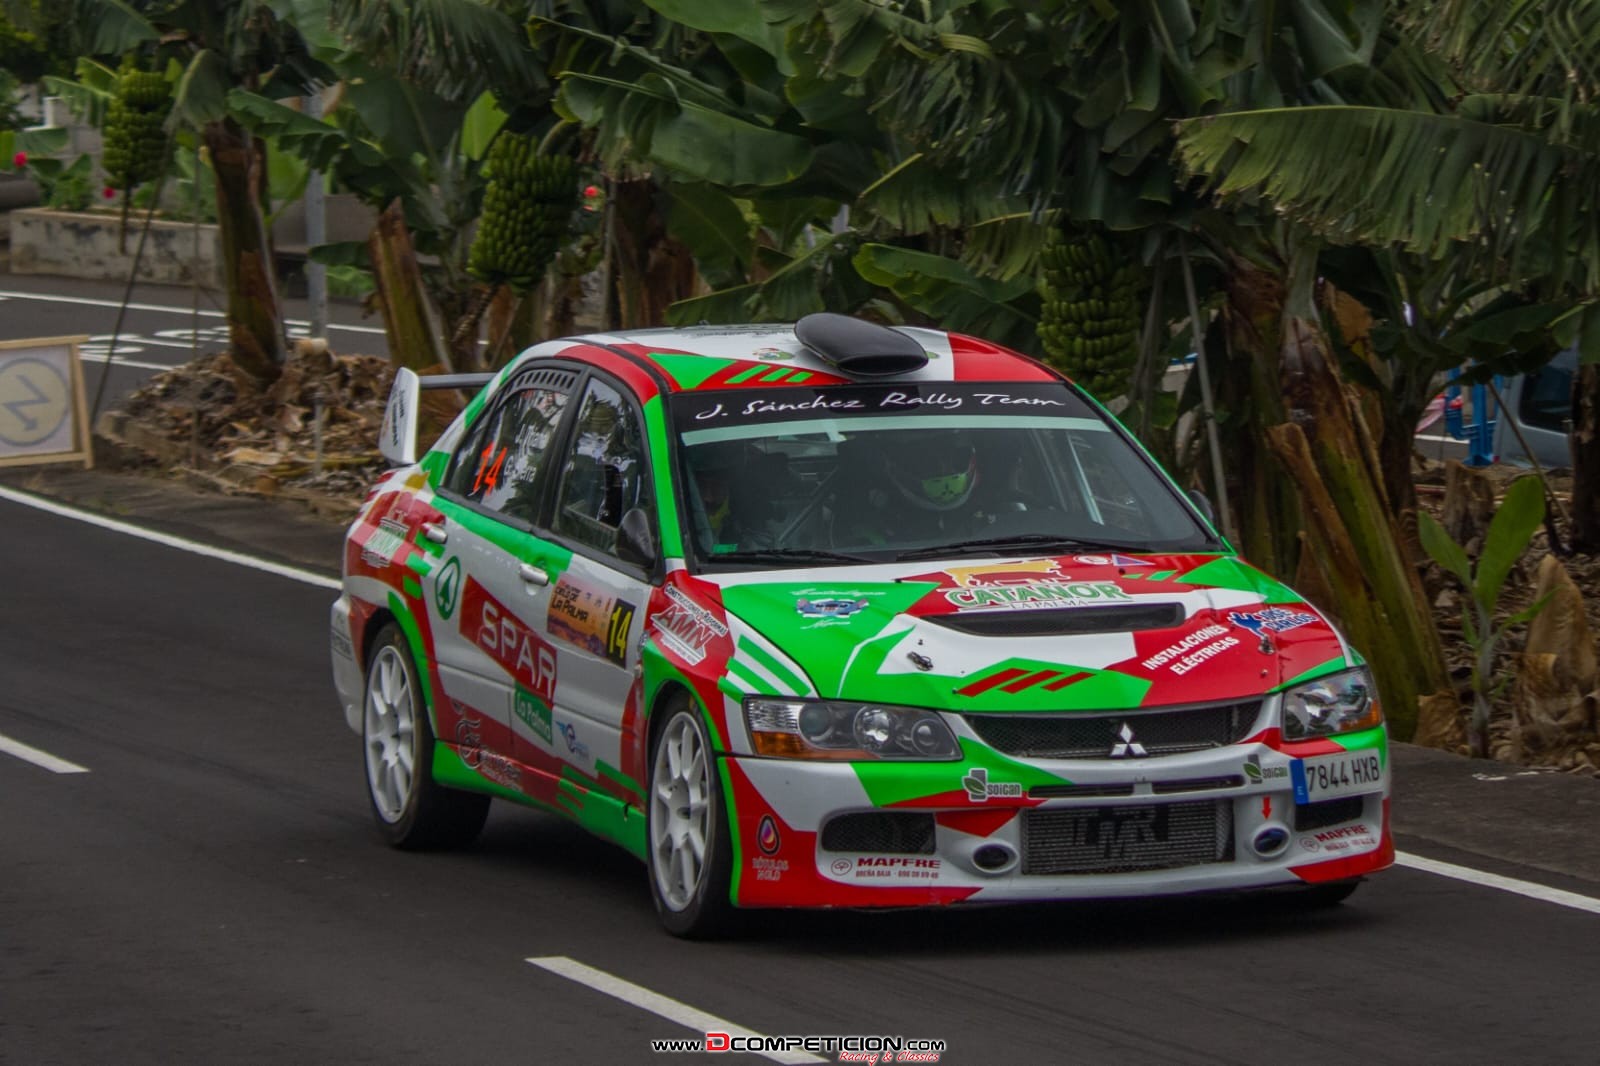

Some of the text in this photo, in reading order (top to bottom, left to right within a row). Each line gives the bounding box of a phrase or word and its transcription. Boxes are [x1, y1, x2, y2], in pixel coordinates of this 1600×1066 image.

[695, 391, 1065, 420] J. Sánchez Rally Team
[472, 441, 508, 497] 14
[947, 582, 1132, 607] CATANOR
[609, 606, 633, 660] 14
[657, 604, 714, 651] AMN
[1141, 624, 1230, 671] INSTALACIONES
[480, 600, 556, 700] SPAR
[1169, 636, 1241, 676] ELÉCTRICAS
[1306, 756, 1380, 793] 7844 HXB
[1313, 824, 1370, 842] MAPFRE
[857, 857, 941, 869] MAPFRE
